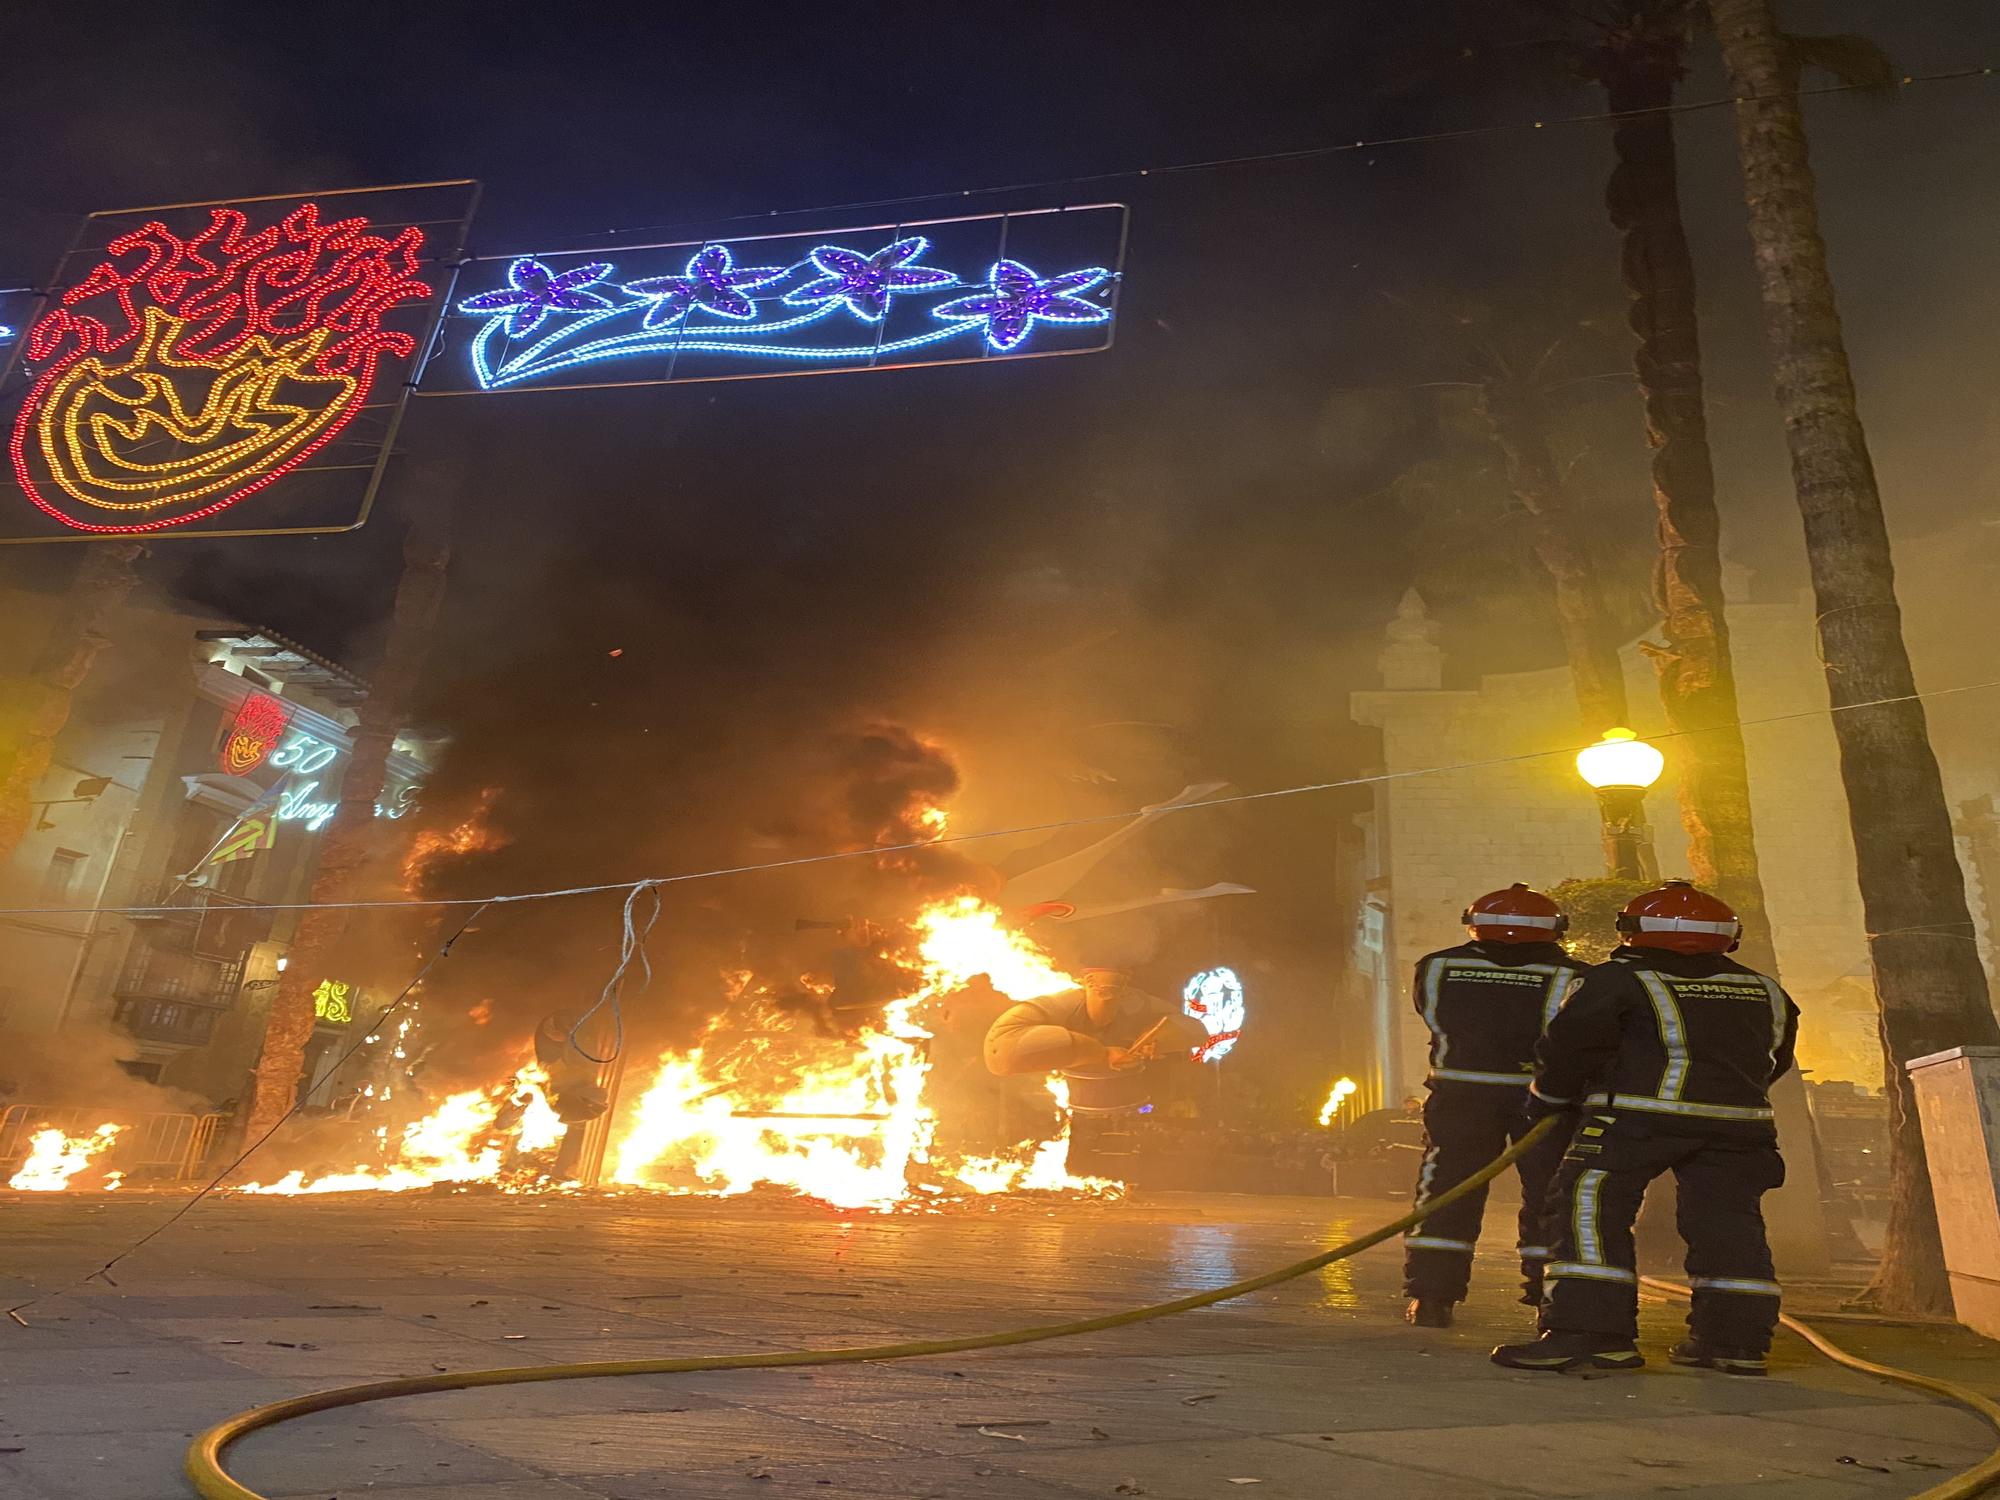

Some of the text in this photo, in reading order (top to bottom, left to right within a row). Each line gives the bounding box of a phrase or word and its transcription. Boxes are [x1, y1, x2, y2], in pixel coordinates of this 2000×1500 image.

[273, 736, 338, 774] 50
[1449, 970, 1544, 983] BOMBERS
[1672, 984, 1767, 996] BOMBERS
